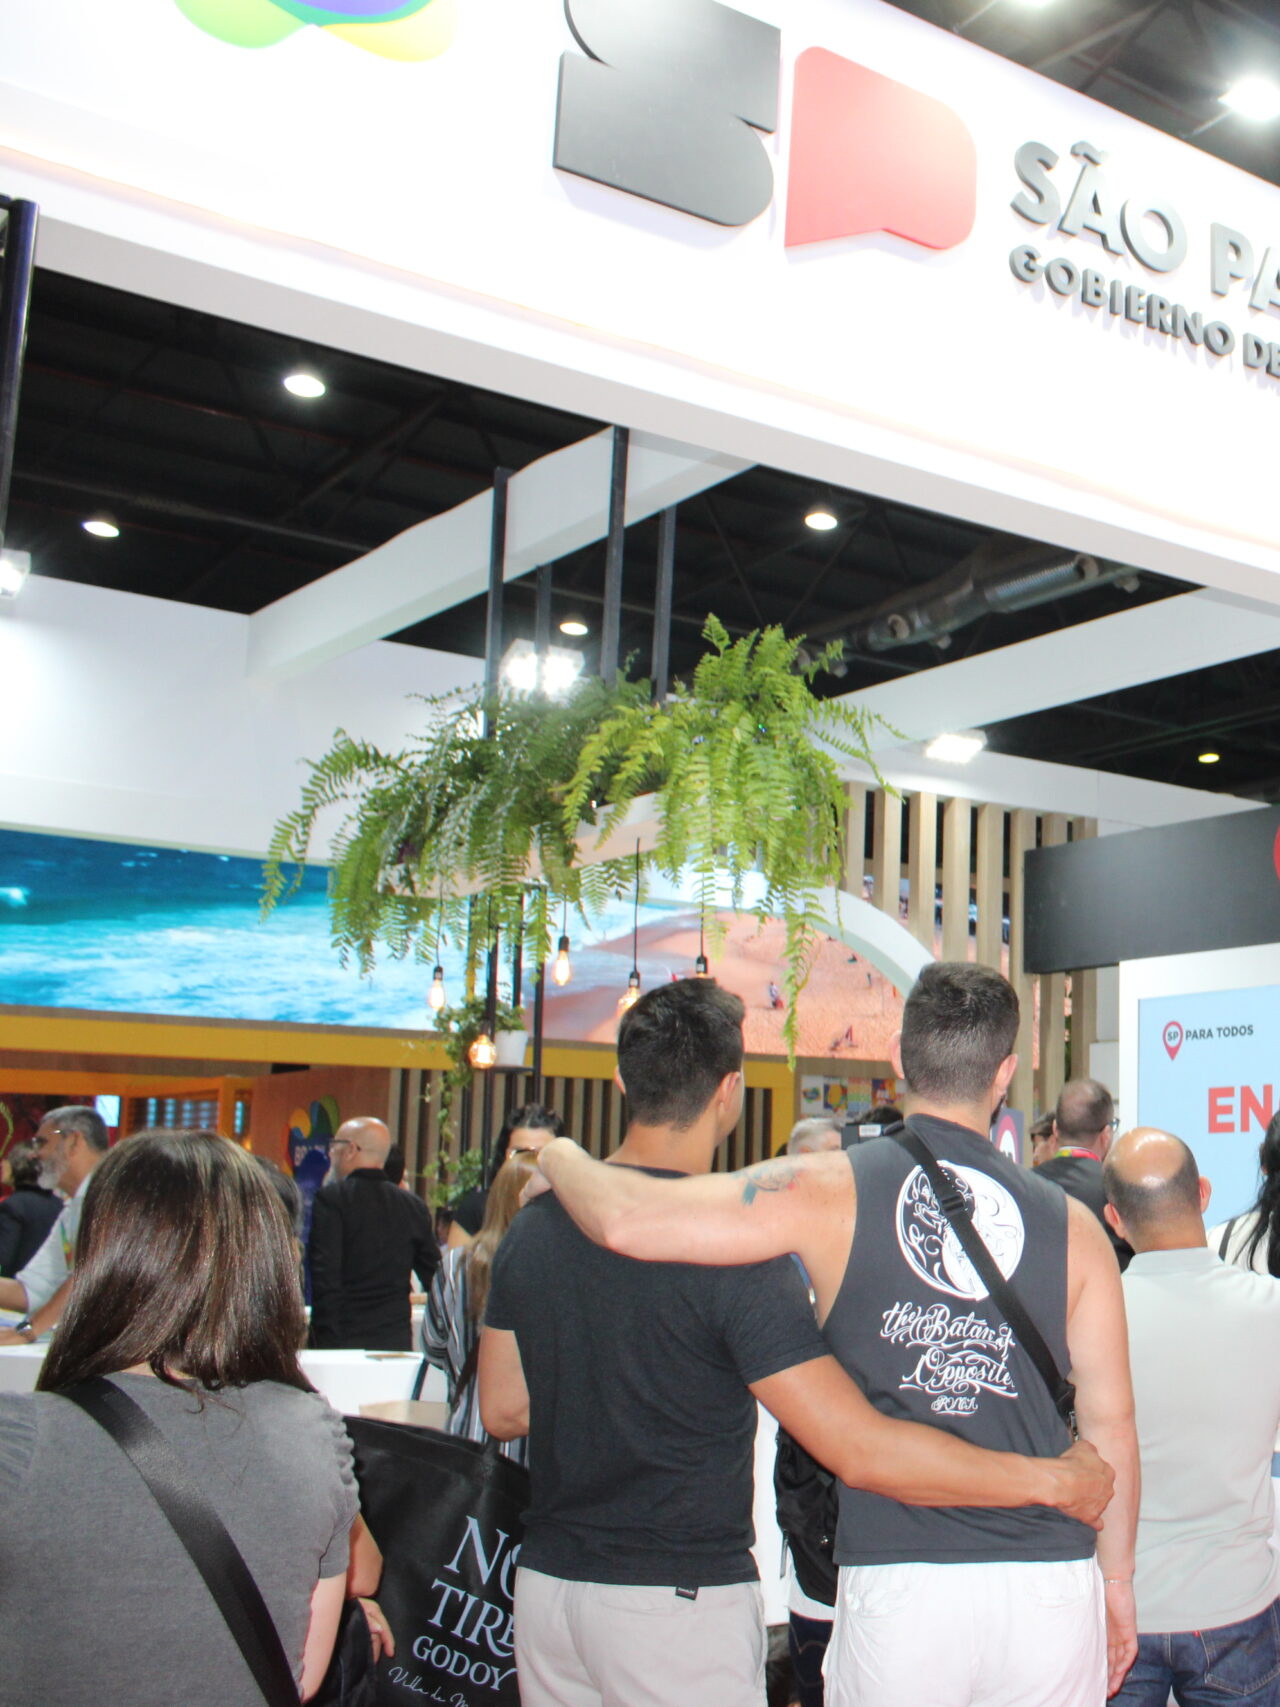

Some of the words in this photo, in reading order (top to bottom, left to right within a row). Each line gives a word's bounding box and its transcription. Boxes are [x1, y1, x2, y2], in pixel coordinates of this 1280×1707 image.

[1010, 140, 1188, 274] SÃO
[1008, 244, 1236, 357] GOBIERNO
[1185, 1028, 1214, 1041] PARA
[1216, 1024, 1254, 1038] TODOS
[412, 1635, 518, 1691] GODOY
